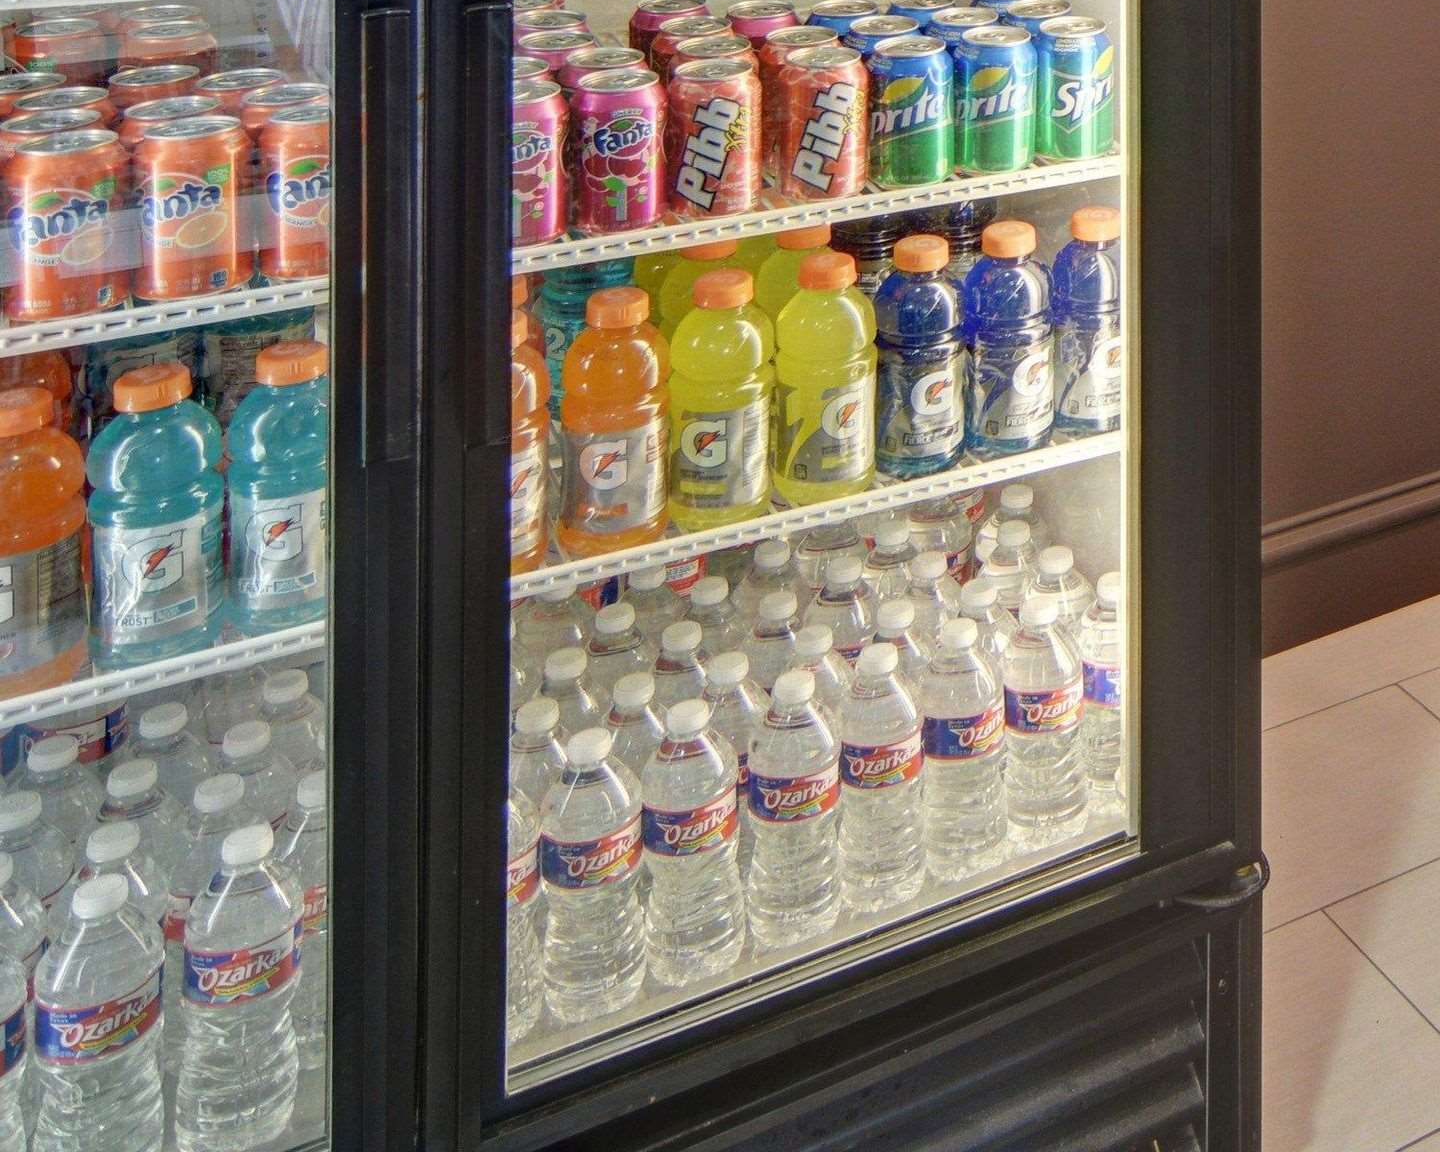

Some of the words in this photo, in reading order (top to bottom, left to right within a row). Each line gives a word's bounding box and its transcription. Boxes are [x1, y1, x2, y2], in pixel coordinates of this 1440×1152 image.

[870, 82, 947, 138] prite
[954, 76, 1030, 128] prite
[594, 119, 654, 158] Fanta
[676, 98, 741, 211] Pibb
[791, 82, 857, 192] Pibb
[579, 439, 628, 490] G
[680, 419, 728, 468] G
[850, 747, 922, 777] Ozarka
[764, 774, 834, 809] Ozarka
[60, 989, 160, 1050] Ozarka
